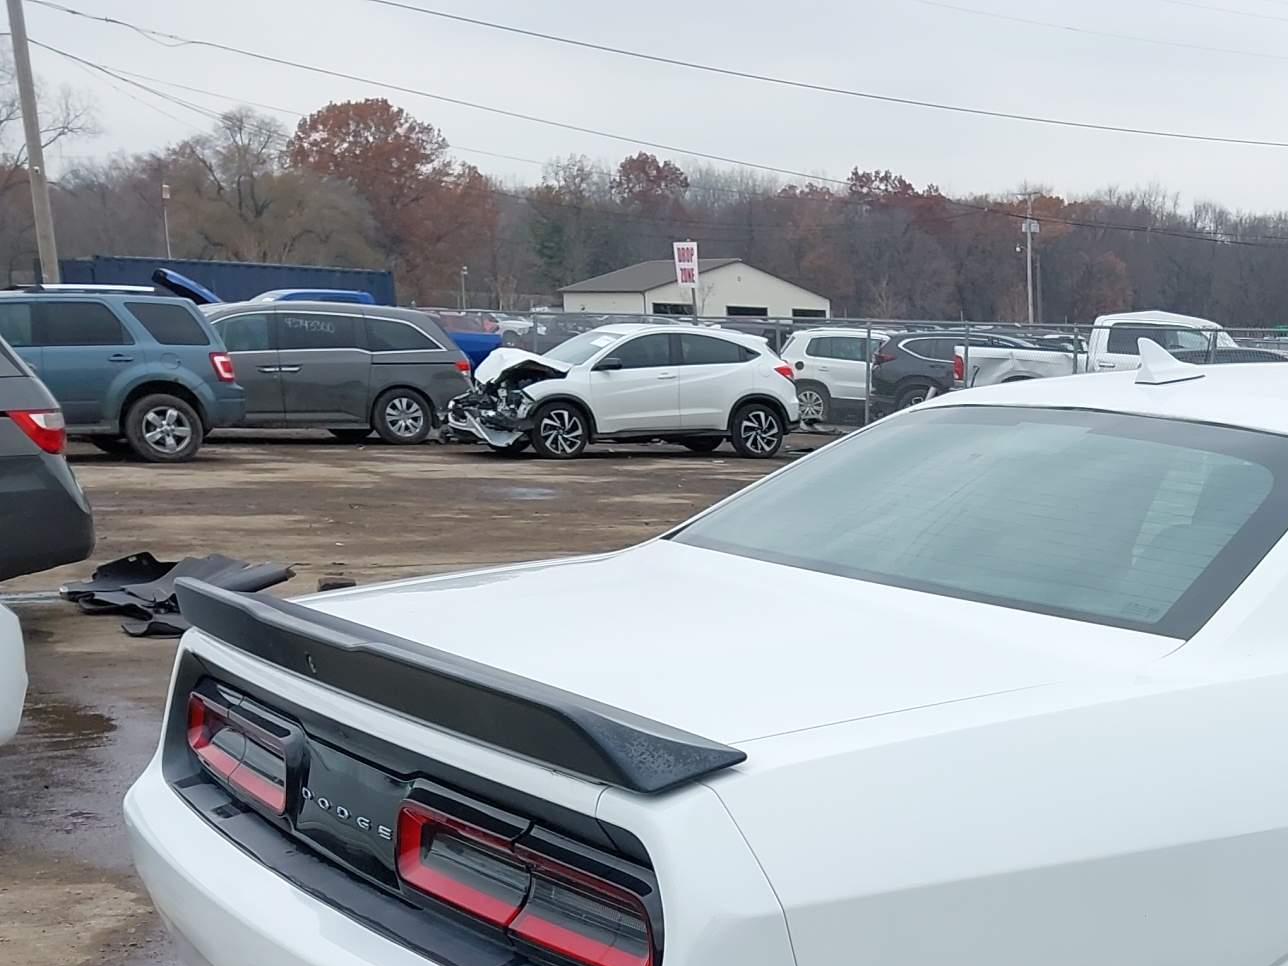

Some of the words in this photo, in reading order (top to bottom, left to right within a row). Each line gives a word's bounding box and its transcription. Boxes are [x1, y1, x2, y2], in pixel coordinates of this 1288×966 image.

[677, 247, 694, 263] DROP
[680, 268, 695, 283] ZONE
[301, 786, 393, 840] DODGE
